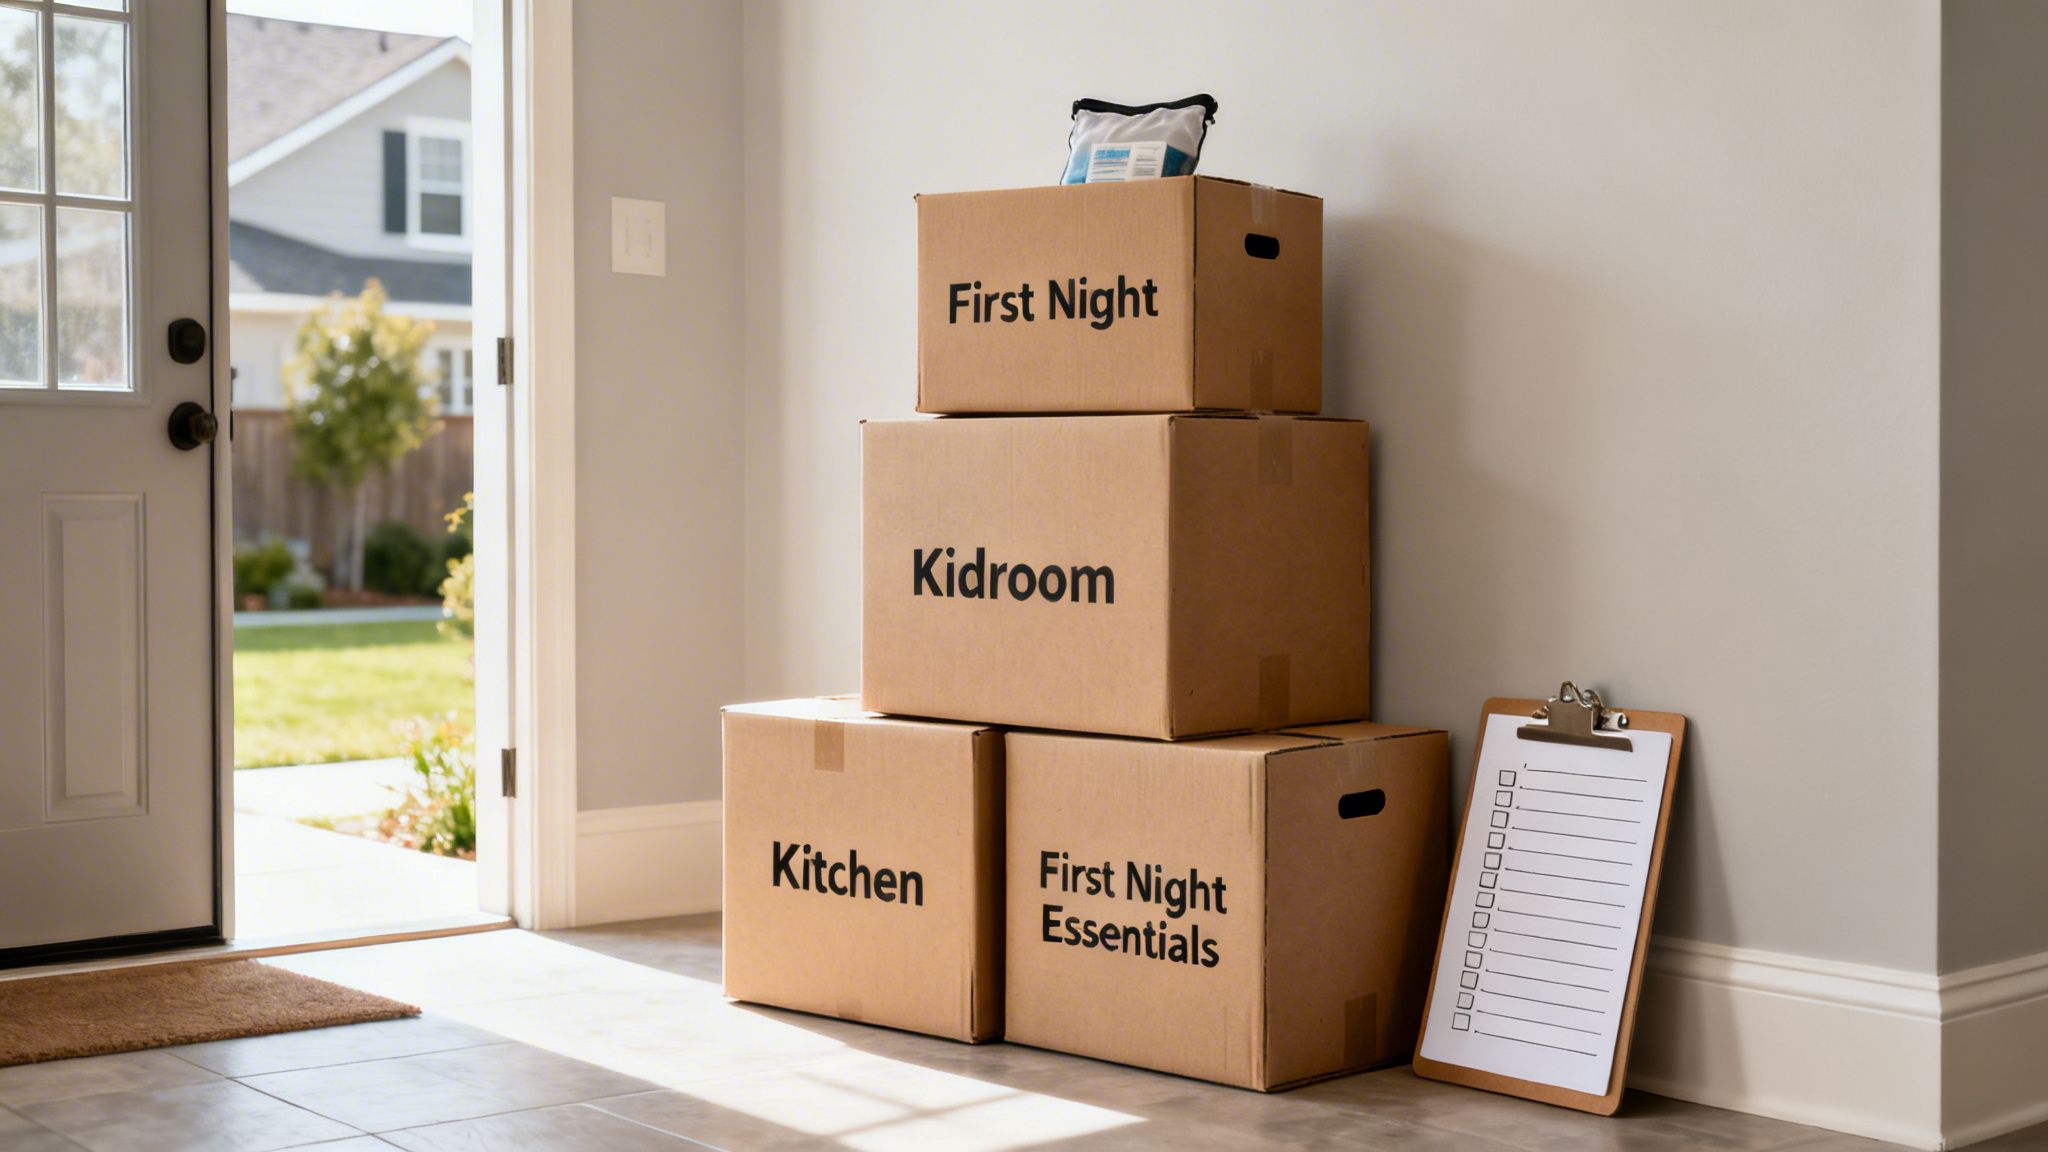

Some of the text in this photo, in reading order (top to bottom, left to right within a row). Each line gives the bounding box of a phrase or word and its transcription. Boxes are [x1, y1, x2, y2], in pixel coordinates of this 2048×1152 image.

[949, 274, 1159, 331] First Night
[913, 547, 1115, 604] Kidroom
[772, 841, 923, 906] Kitchen
[1040, 850, 1228, 919] First Night
[1042, 903, 1220, 968] Essentials
